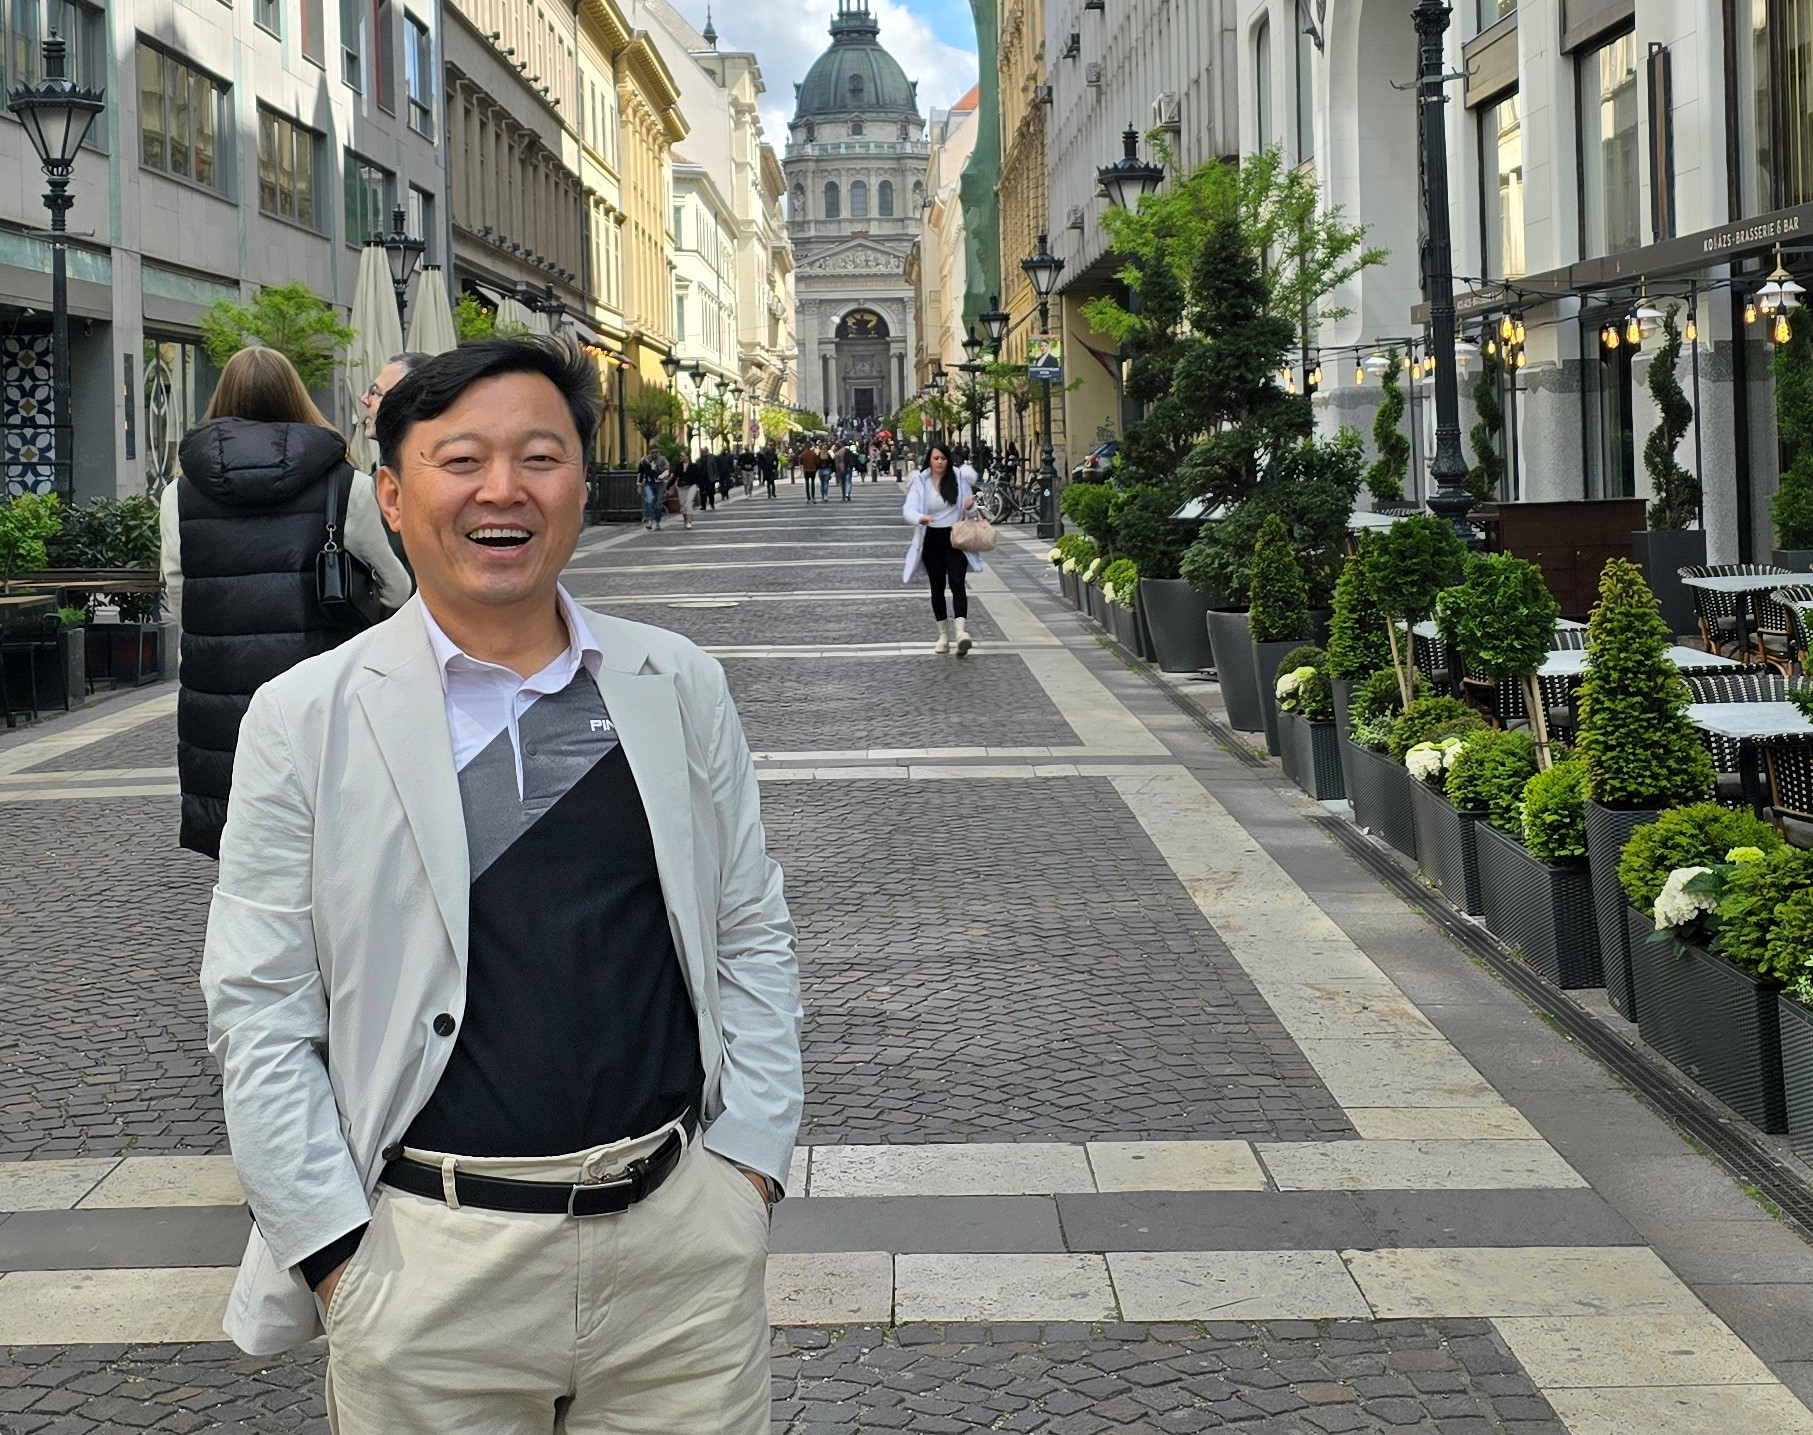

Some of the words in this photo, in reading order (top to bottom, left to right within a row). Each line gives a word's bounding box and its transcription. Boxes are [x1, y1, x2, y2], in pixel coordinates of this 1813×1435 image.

[1735, 222, 1775, 244] BRASSERIE
[1776, 219, 1782, 235] &
[1783, 216, 1799, 233] BAR
